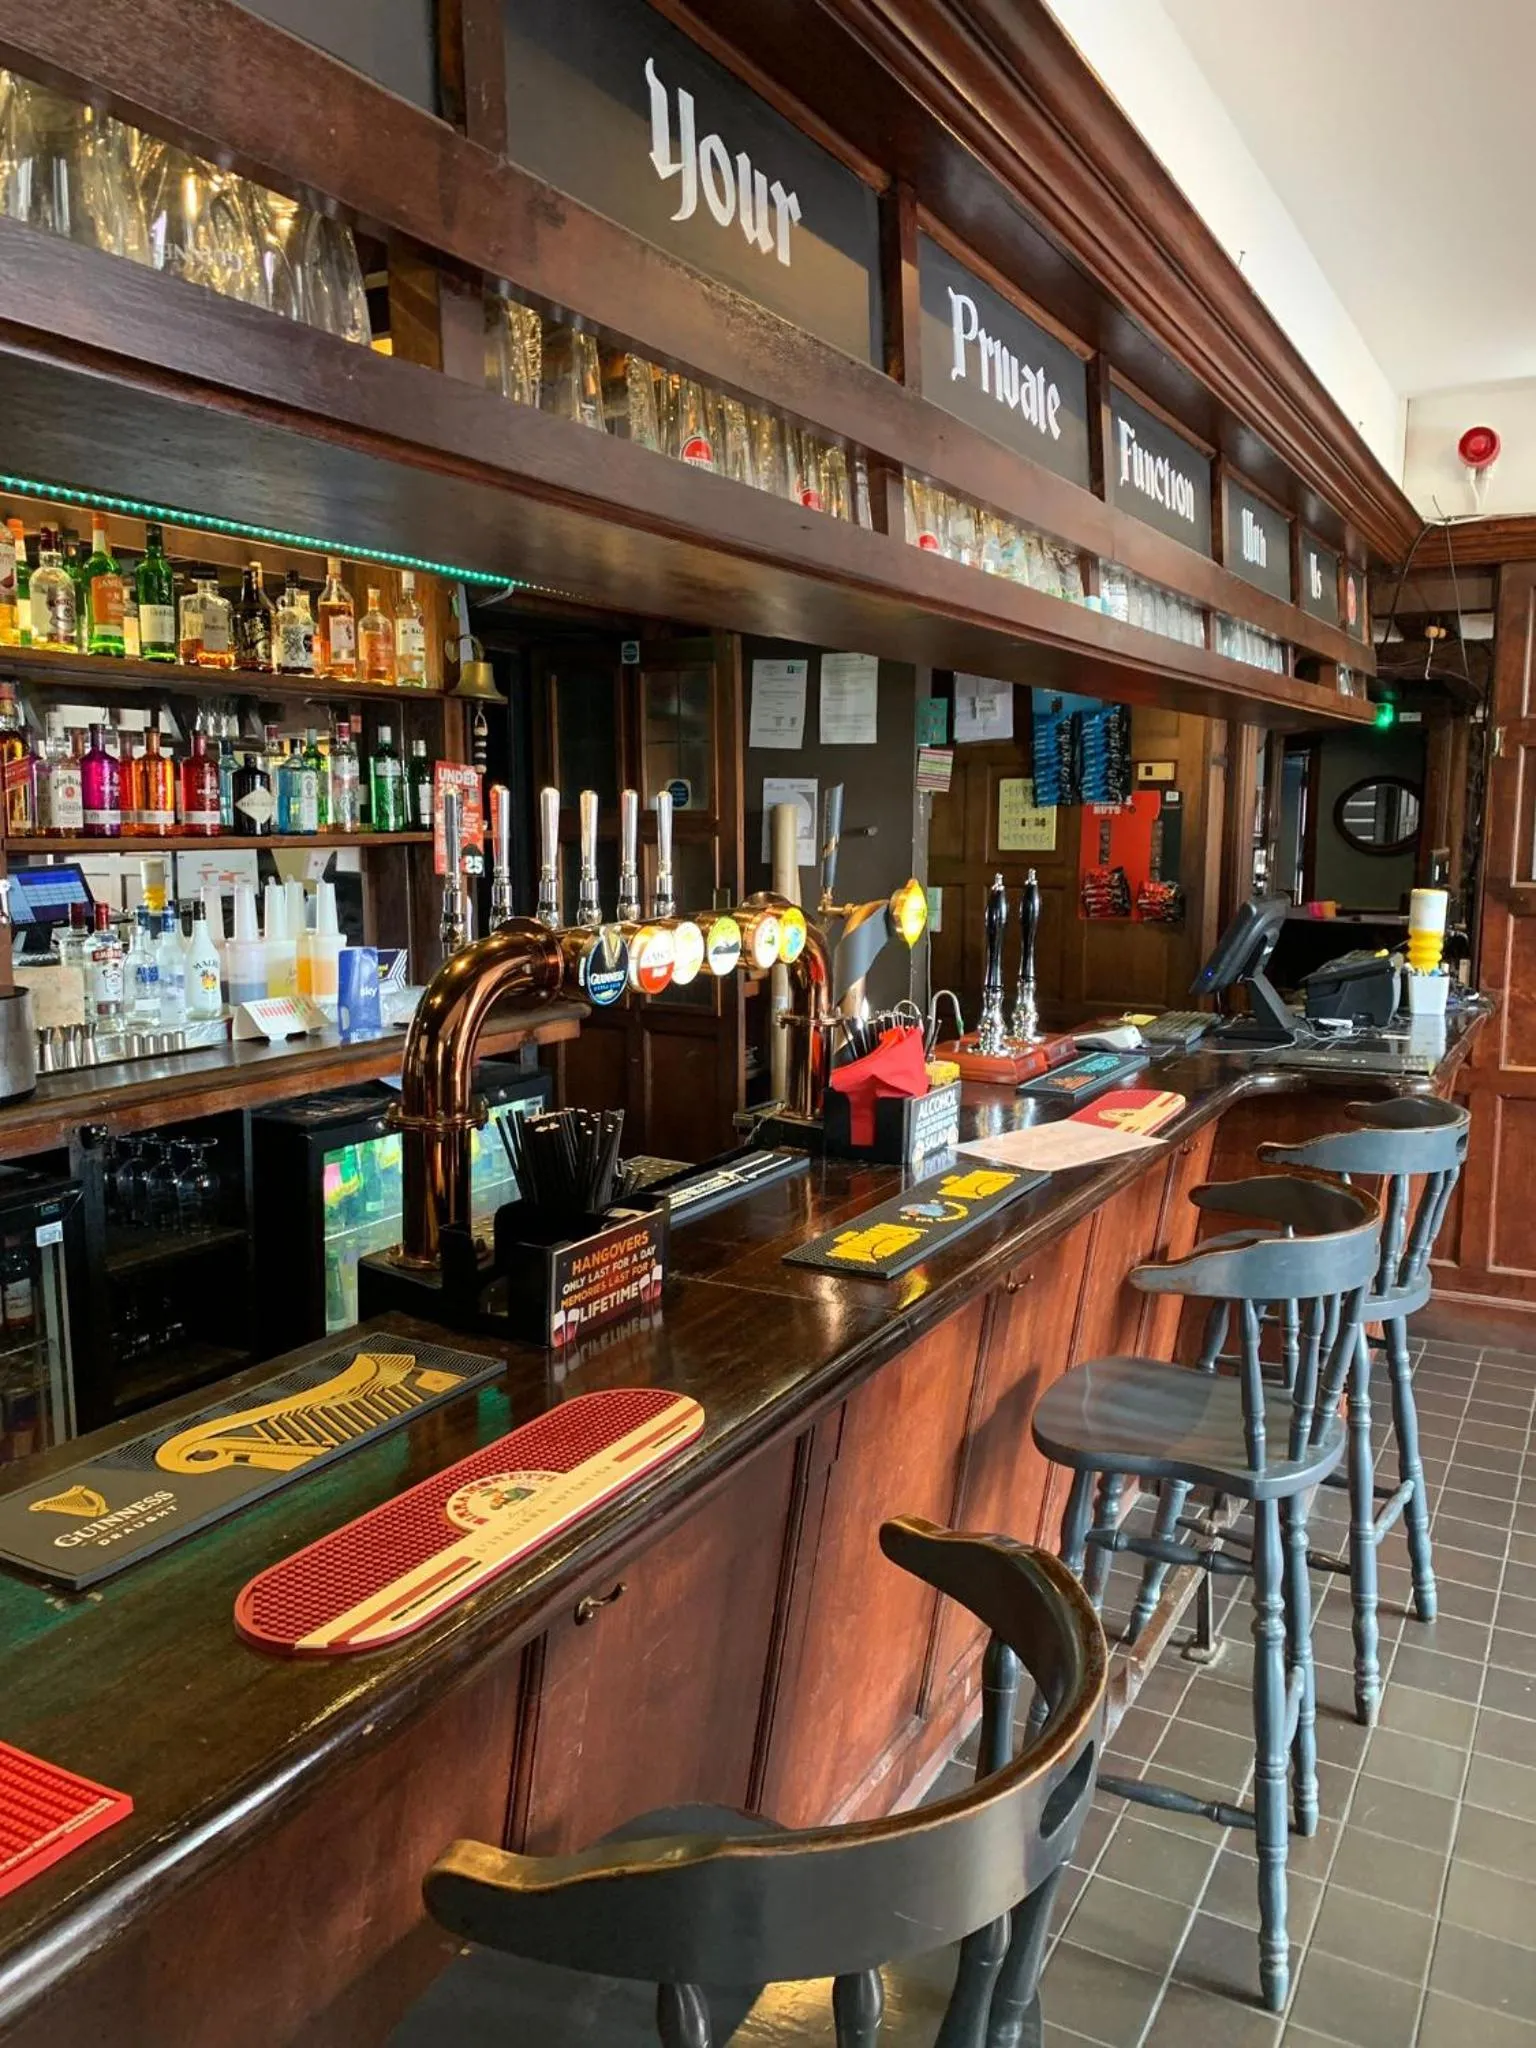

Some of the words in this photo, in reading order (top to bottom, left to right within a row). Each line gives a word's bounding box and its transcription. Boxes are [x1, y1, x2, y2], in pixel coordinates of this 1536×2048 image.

[645, 57, 802, 267] Your
[948, 286, 1061, 440] Private
[1117, 416, 1195, 524] Function
[438, 767, 479, 789] UNDER
[1094, 805, 1121, 815] NUTS
[464, 855, 484, 875] 25
[360, 984, 378, 998] sky
[917, 1088, 957, 1122] ALCOHOL
[562, 1276, 586, 1295] ONLY
[588, 1264, 611, 1284] LAST
[612, 1257, 629, 1271] FOR
[631, 1252, 639, 1264] A
[640, 1244, 657, 1261] DAY
[572, 1230, 650, 1276] HANGOVERS
[561, 1280, 607, 1309] MEMORIES
[608, 1268, 630, 1289] LAST
[631, 1261, 648, 1276] FOR
[650, 1257, 657, 1269] A
[580, 1281, 640, 1323] LIFETIME
[53, 1490, 174, 1548] GUINNESS
[97, 1505, 177, 1547] DRAUGHT
